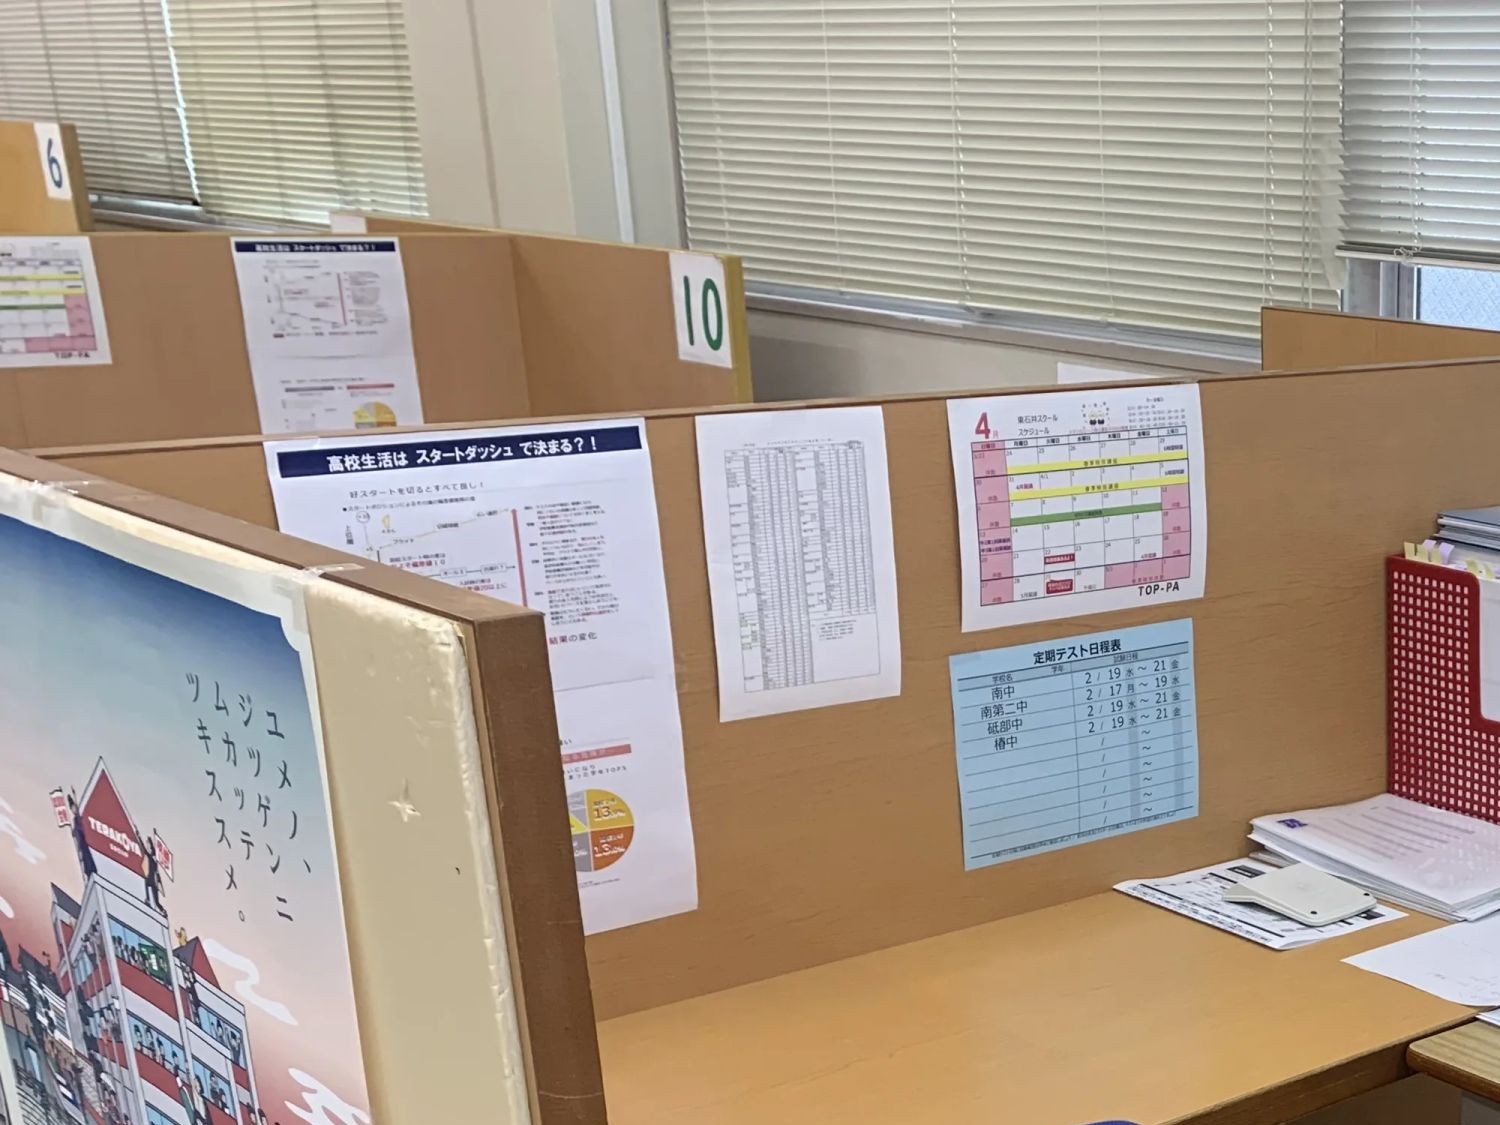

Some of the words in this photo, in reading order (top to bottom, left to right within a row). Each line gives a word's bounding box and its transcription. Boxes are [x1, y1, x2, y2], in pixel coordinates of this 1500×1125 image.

[47, 138, 63, 189] 6
[683, 275, 723, 351] 10
[1018, 427, 1050, 436] スケジュール
[327, 451, 408, 473] 高校生活は
[416, 443, 514, 465] スタートダッシュ
[1138, 581, 1180, 597] TOP-PA
[1033, 638, 1122, 665] 定期テスト日程表
[991, 673, 1014, 684] 学校名
[1085, 672, 1092, 684] 2
[1108, 666, 1121, 680] 19
[1125, 667, 1135, 677] 水
[1153, 659, 1166, 672] 21
[1171, 659, 1180, 669] 金
[991, 686, 1016, 701] 南中
[1086, 688, 1093, 700] 2
[1109, 683, 1122, 696] 17
[1126, 683, 1135, 694] 月
[1155, 675, 1168, 688] 19
[1171, 675, 1181, 685] 水
[980, 701, 1028, 720] 南第二中
[1087, 704, 1094, 717] 2
[1110, 700, 1123, 712] 19
[1127, 700, 1137, 710] 水
[1155, 691, 1167, 703] 21
[1172, 691, 1181, 701] 金
[986, 718, 1023, 735] 砥部中
[1088, 721, 1095, 733] 2
[1111, 716, 1124, 729] 19
[1128, 717, 1137, 726] 水
[1155, 707, 1168, 719] 21
[1172, 707, 1181, 717] 金
[238, 694, 294, 922] ジツゲンニ
